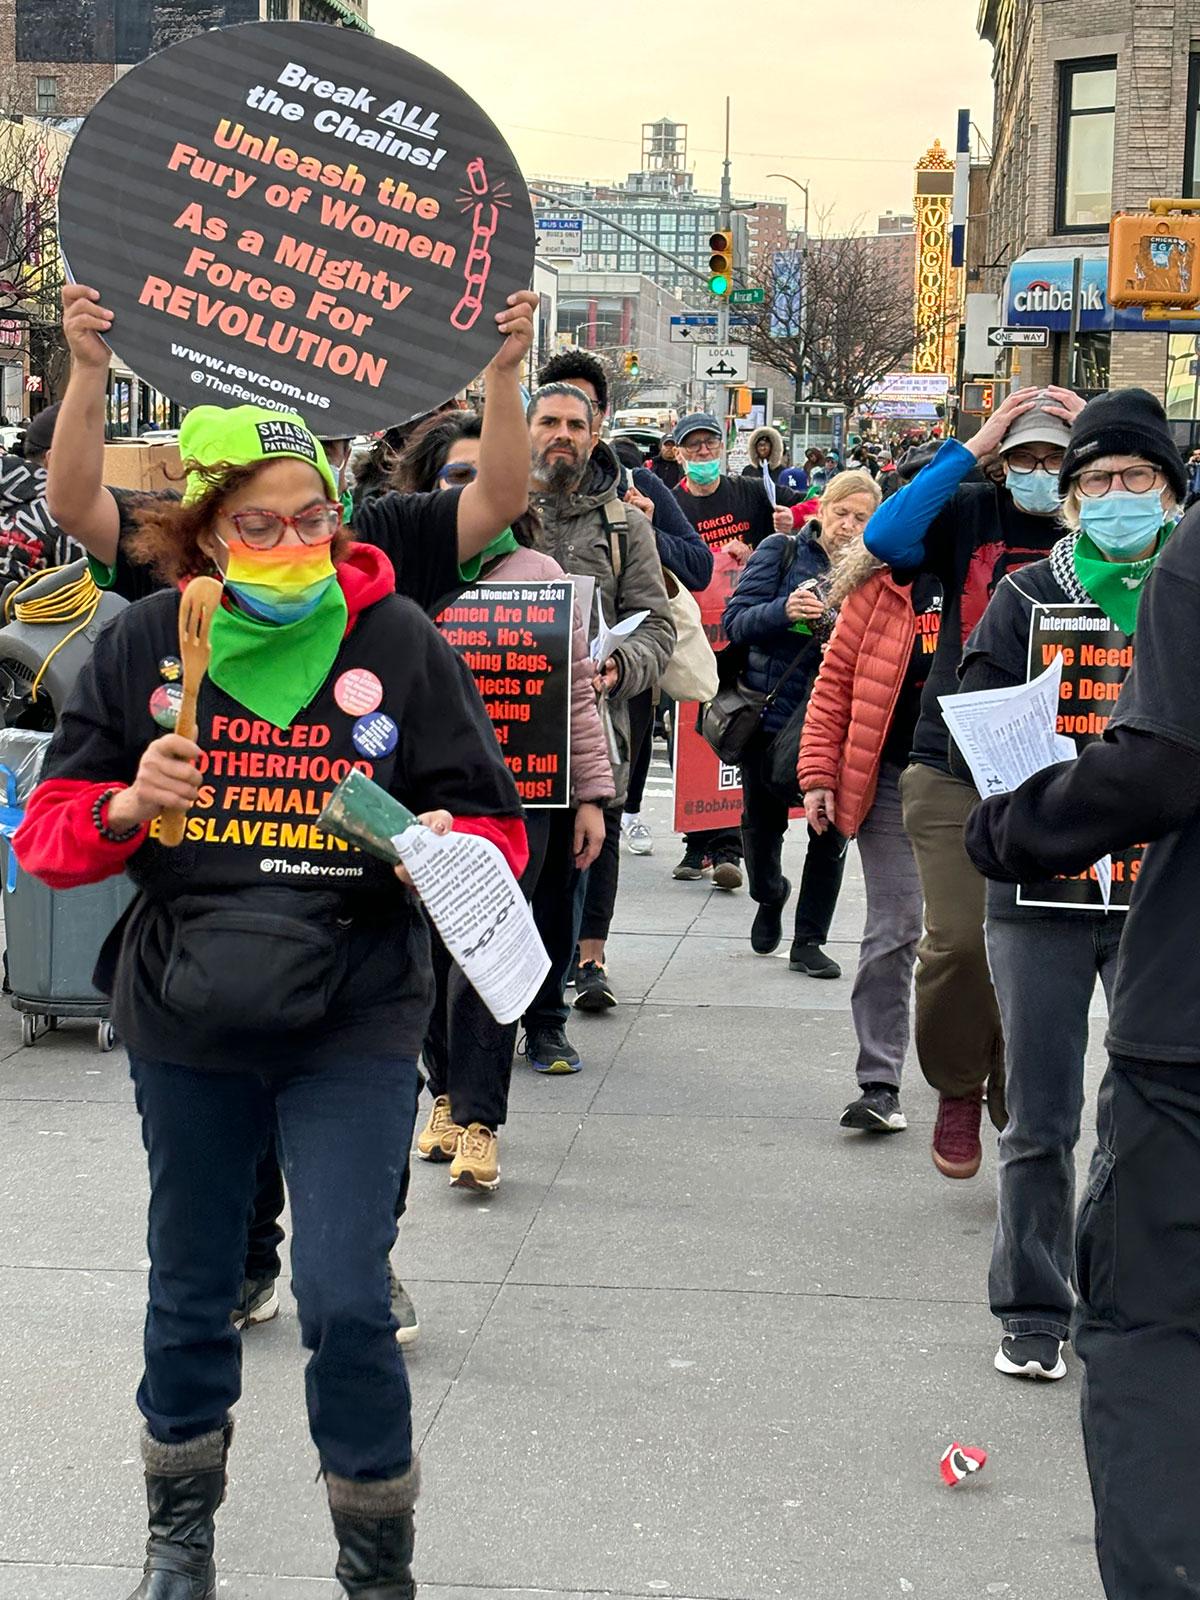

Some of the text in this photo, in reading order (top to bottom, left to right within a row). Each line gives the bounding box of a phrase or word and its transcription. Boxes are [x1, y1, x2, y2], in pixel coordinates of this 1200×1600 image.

[277, 62, 440, 138] Break ALL
[246, 85, 448, 170] the Chains!
[213, 119, 440, 220] Unleash the
[167, 142, 457, 268] Fury of Women
[542, 221, 557, 229] BUS
[173, 202, 413, 311] As a Mighty
[183, 247, 374, 337] Force For
[1013, 283, 1104, 312] citibank
[138, 275, 388, 388] REVOLUTION
[995, 333, 1042, 341] ONE WAY
[709, 349, 735, 357] LOCAL
[171, 343, 331, 409] www.revcom.us
[190, 370, 298, 415] @TheRevcoms
[258, 422, 312, 444] SMASH
[697, 513, 734, 531] FORCED
[481, 588, 520, 601] Women's
[522, 589, 538, 602] Day
[539, 589, 565, 601] 2024!
[494, 605, 522, 623] Are
[527, 606, 555, 623] Not
[1040, 615, 1110, 631] International
[498, 628, 537, 648] Ho's,
[506, 652, 552, 672] Bags,
[1081, 645, 1133, 668] Need
[525, 679, 544, 695] or
[211, 715, 331, 748] FORCED
[189, 749, 374, 784] OTHERHOOD
[527, 754, 558, 773] Full
[259, 858, 364, 877] @TheRevcoms
